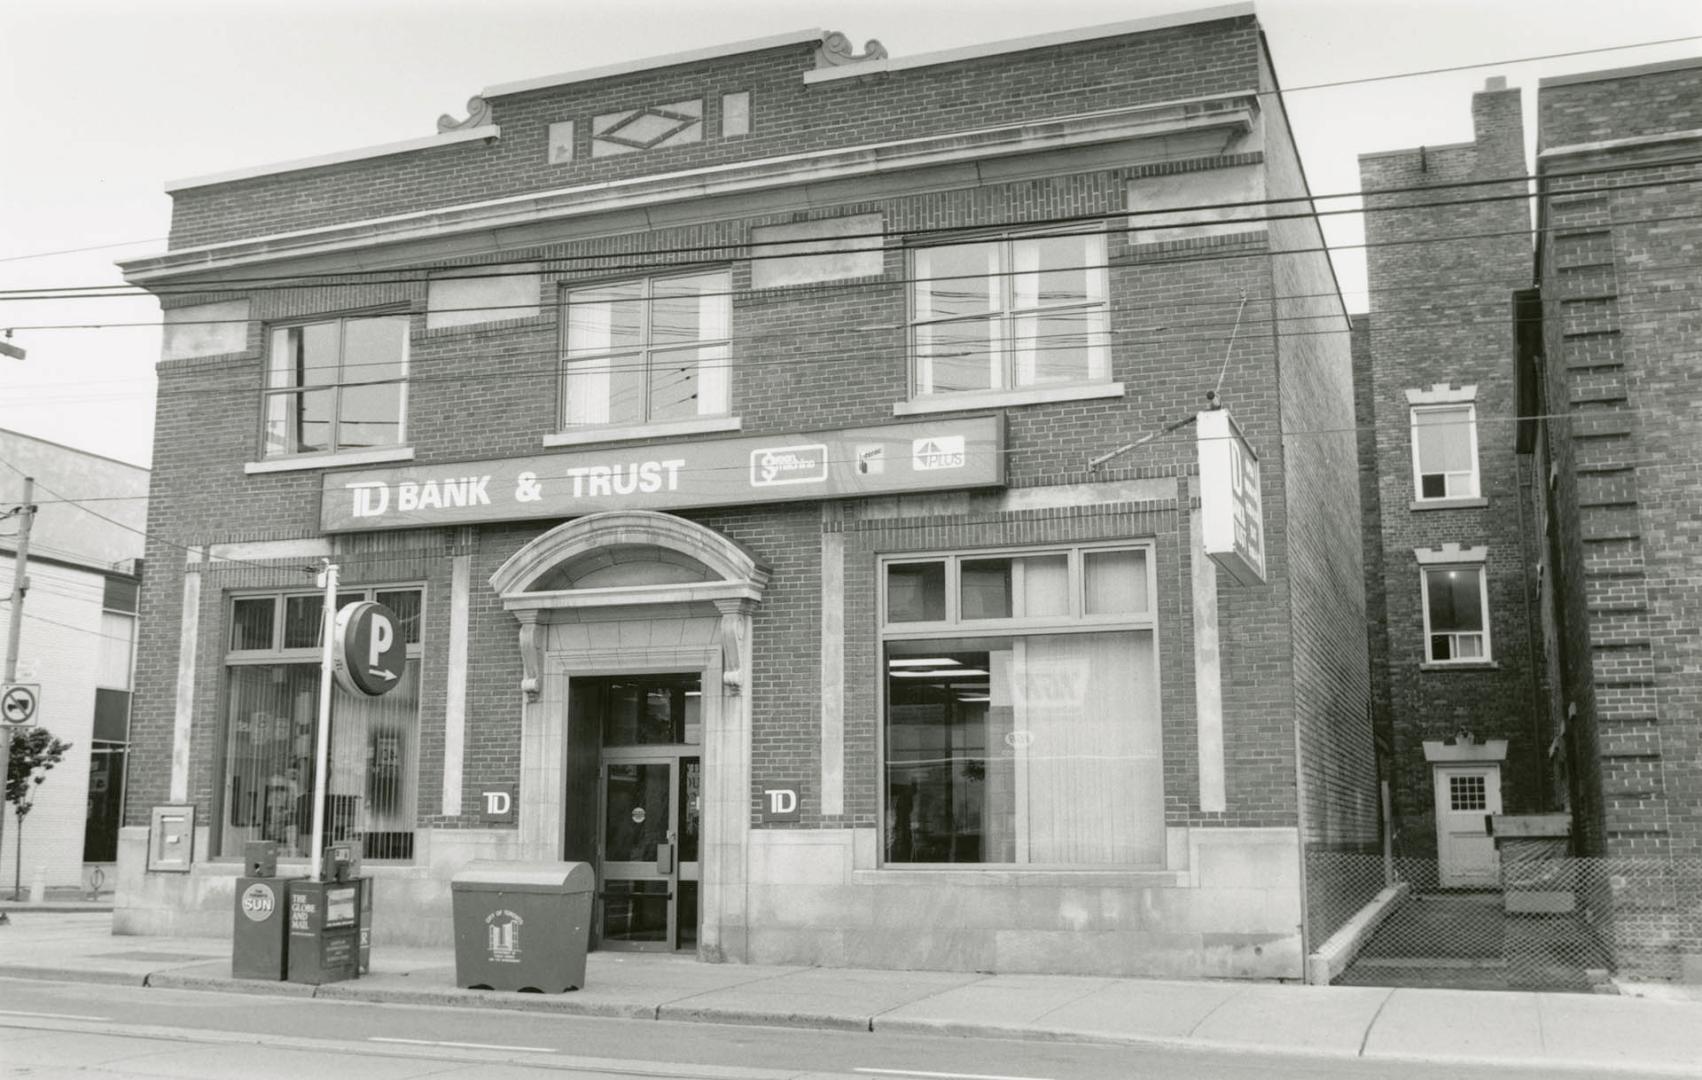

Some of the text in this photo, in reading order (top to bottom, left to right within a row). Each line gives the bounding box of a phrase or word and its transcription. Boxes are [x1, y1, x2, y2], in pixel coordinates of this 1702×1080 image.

[928, 452, 963, 467] PLUS
[345, 459, 686, 518] TD BANK & TRUST
[368, 612, 394, 667] P
[482, 791, 511, 815] TD
[764, 788, 798, 814] TD
[244, 898, 273, 912] SUN
